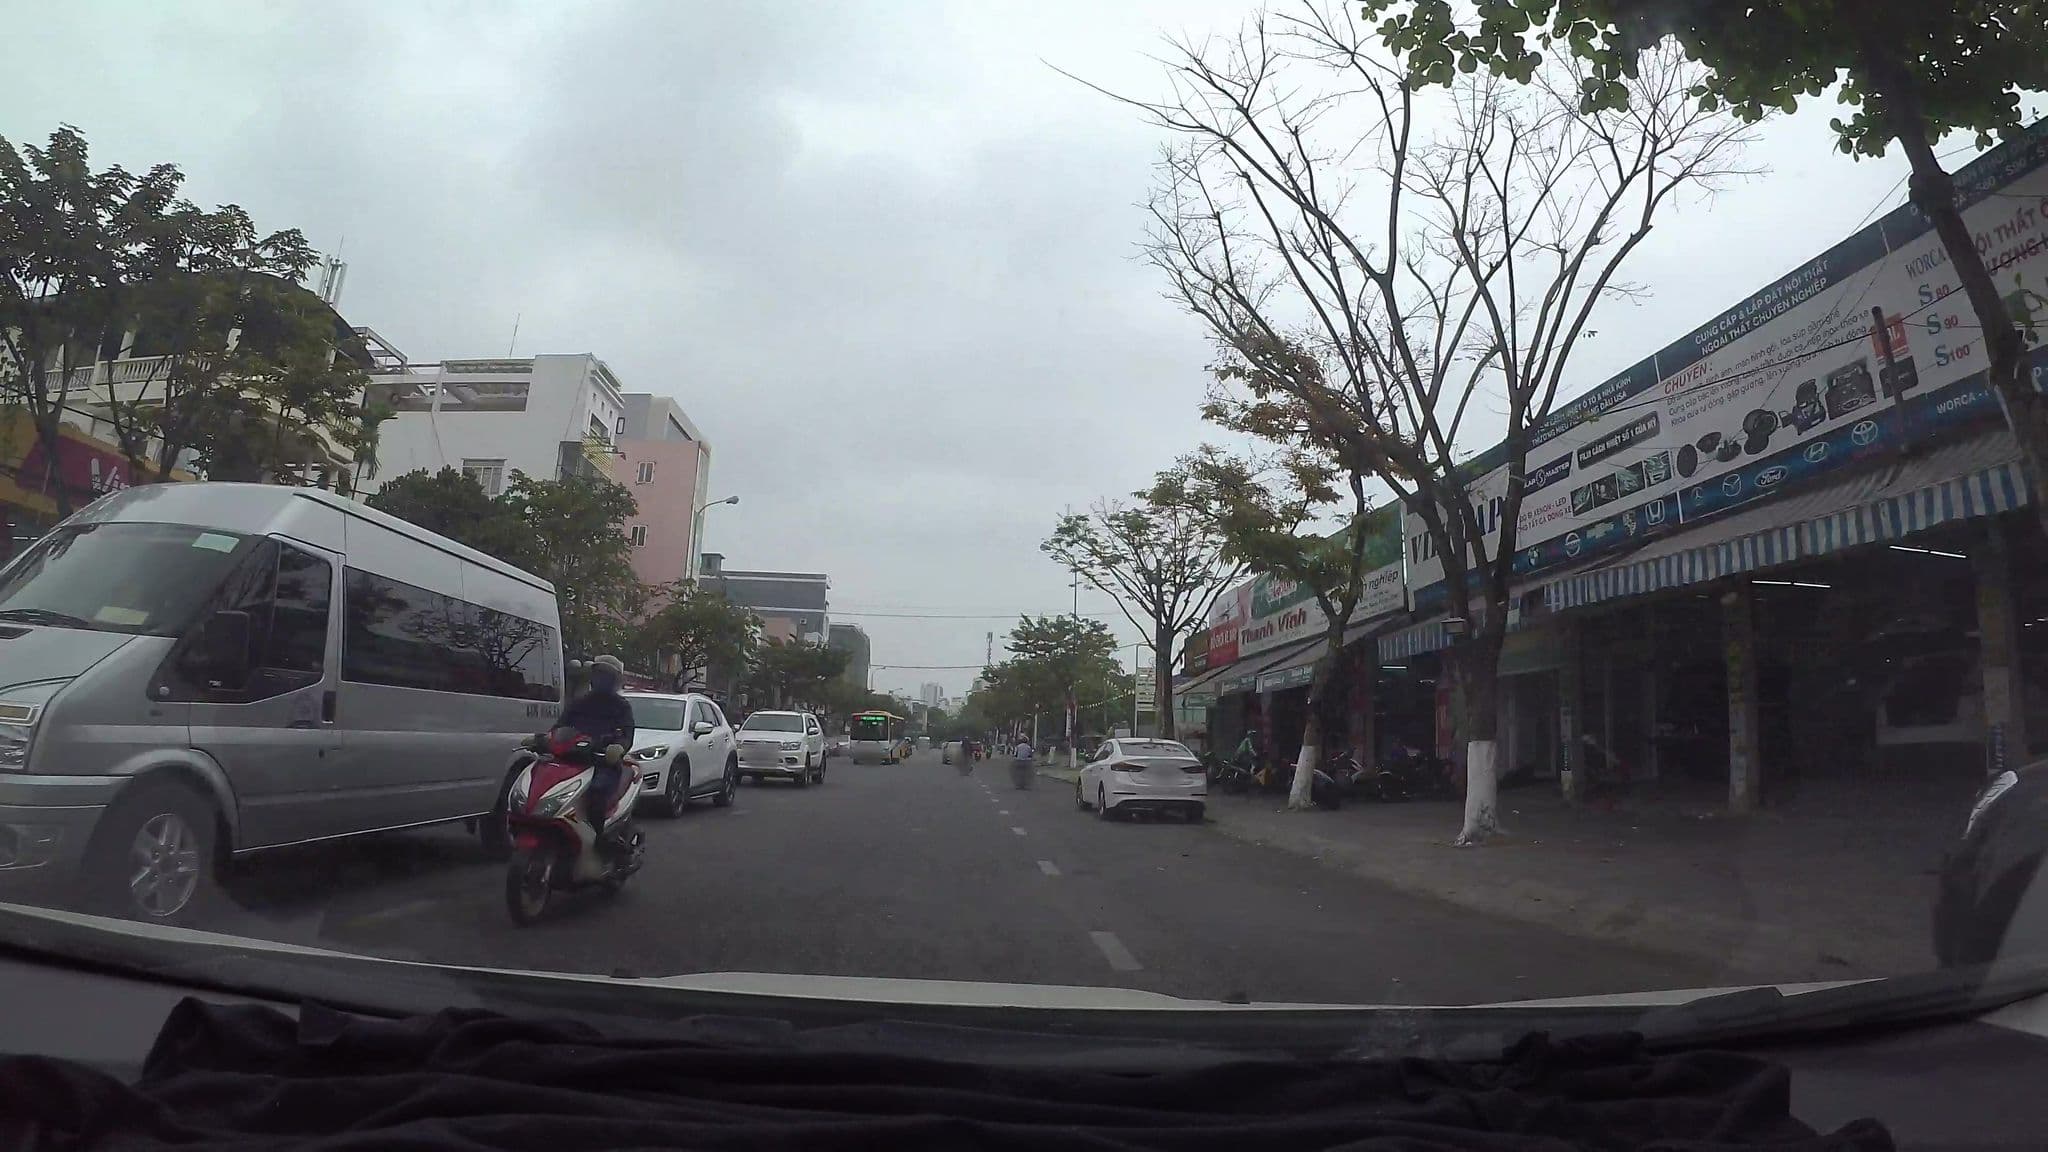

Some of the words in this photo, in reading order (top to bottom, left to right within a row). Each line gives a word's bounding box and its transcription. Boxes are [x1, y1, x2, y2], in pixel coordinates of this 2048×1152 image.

[1695, 323, 1719, 346] CUNG
[1718, 311, 1738, 330] CẤP
[1738, 310, 1746, 321] &
[1803, 257, 1830, 283] THẤT
[1728, 319, 1752, 342] THẤT
[1936, 391, 1977, 415] WORCA
[1621, 429, 1631, 445] SỐ
[1554, 495, 1568, 508] LED
[1564, 504, 1573, 515] XE
[1368, 569, 1400, 592] nghiệp
[1241, 619, 1274, 646] Thanh
